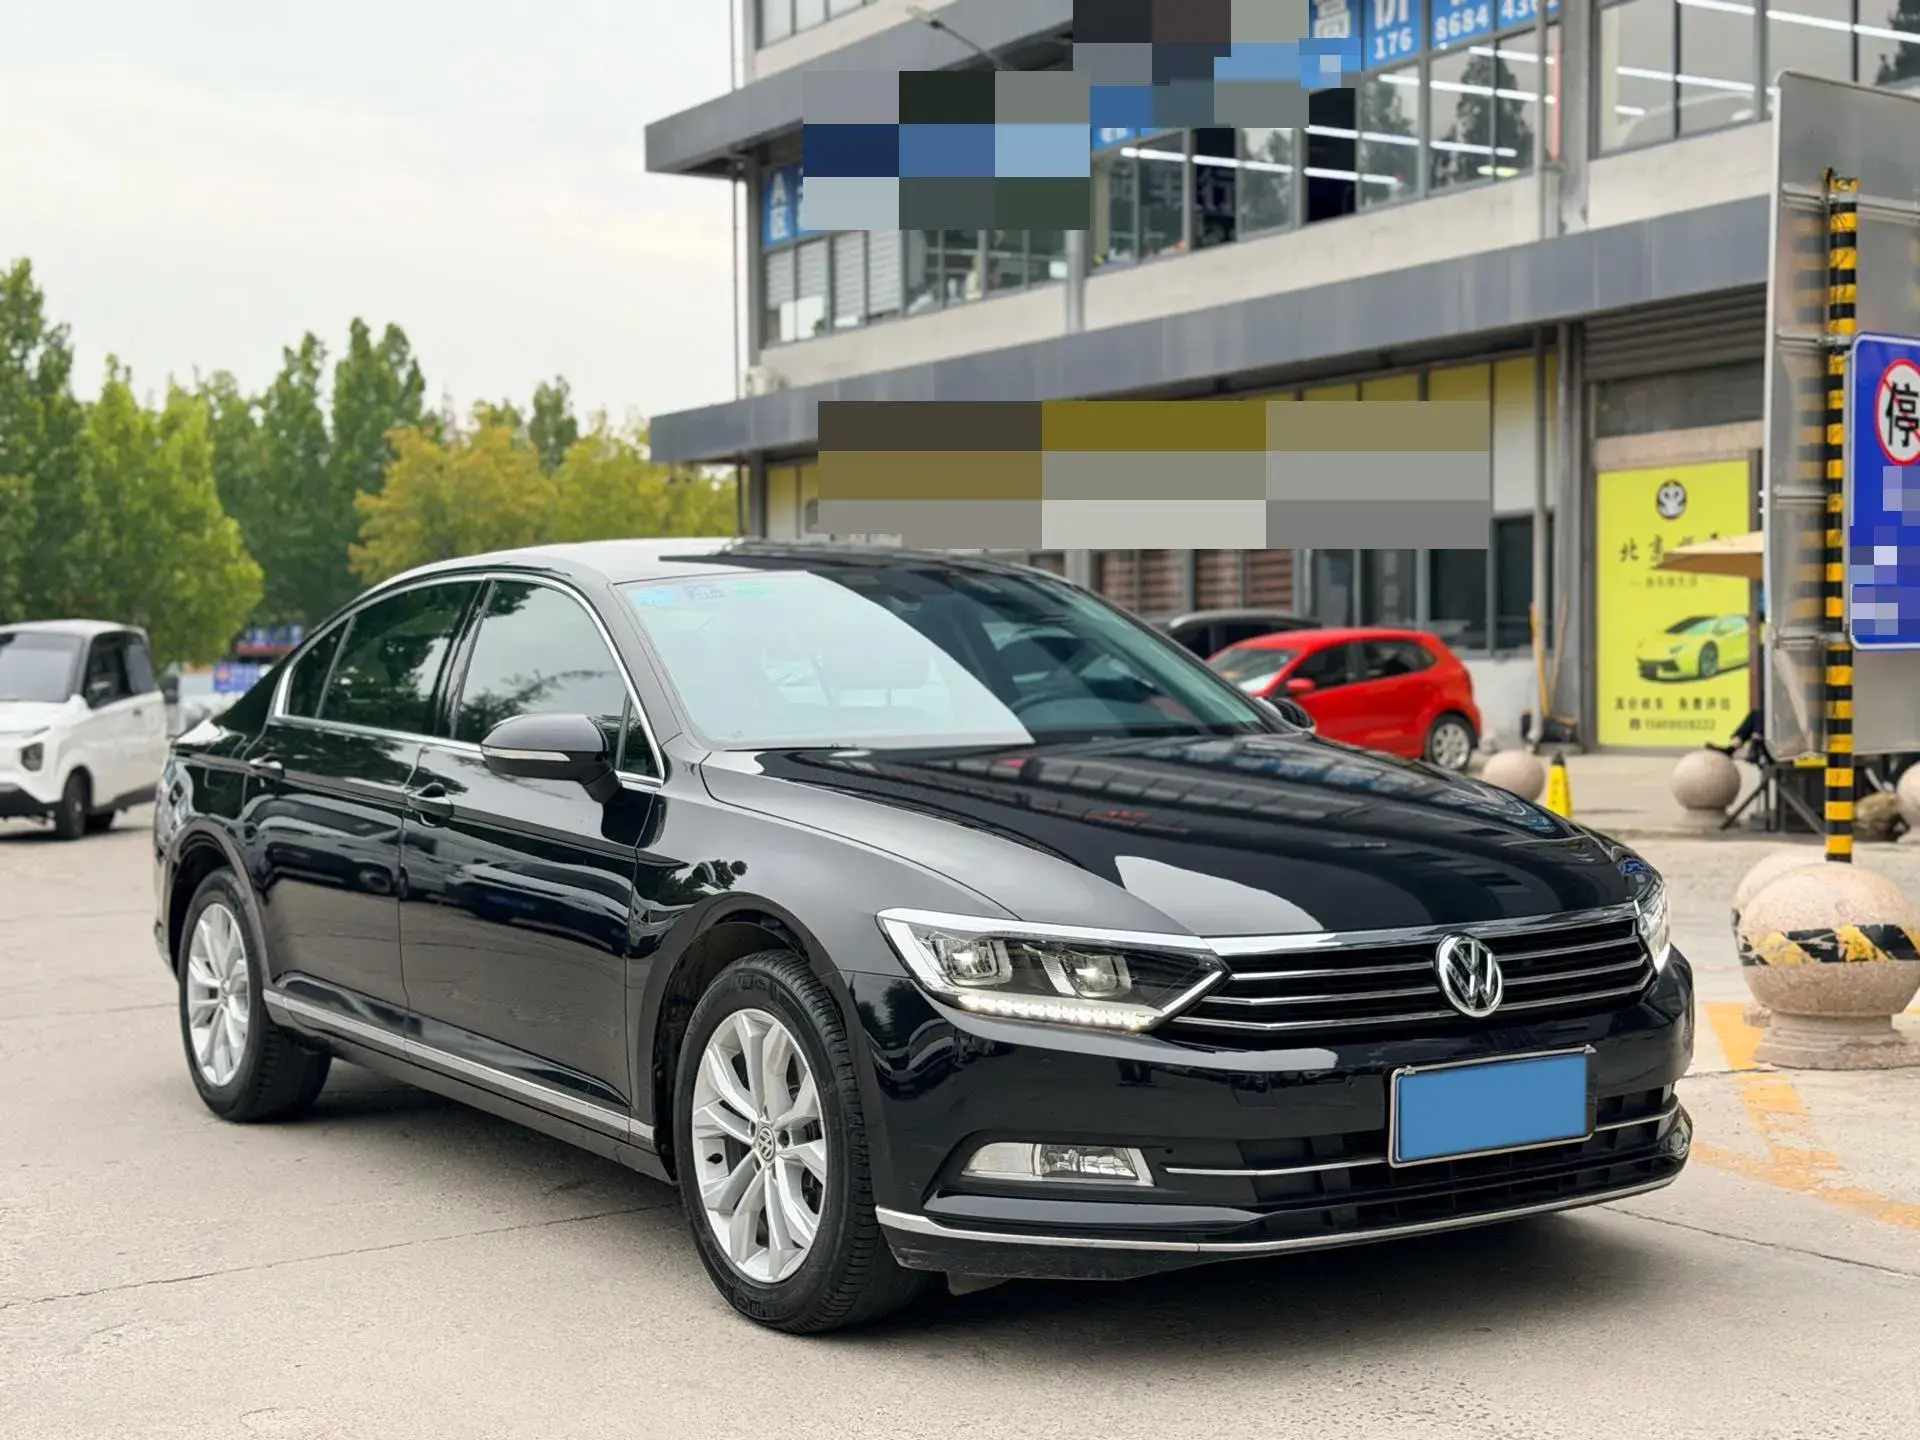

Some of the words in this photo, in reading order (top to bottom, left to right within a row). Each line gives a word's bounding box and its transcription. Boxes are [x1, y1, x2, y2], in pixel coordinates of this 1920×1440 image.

[1374, 27, 1412, 59] 176
[1435, 5, 1489, 40] 8684
[1885, 381, 1920, 448] 停
